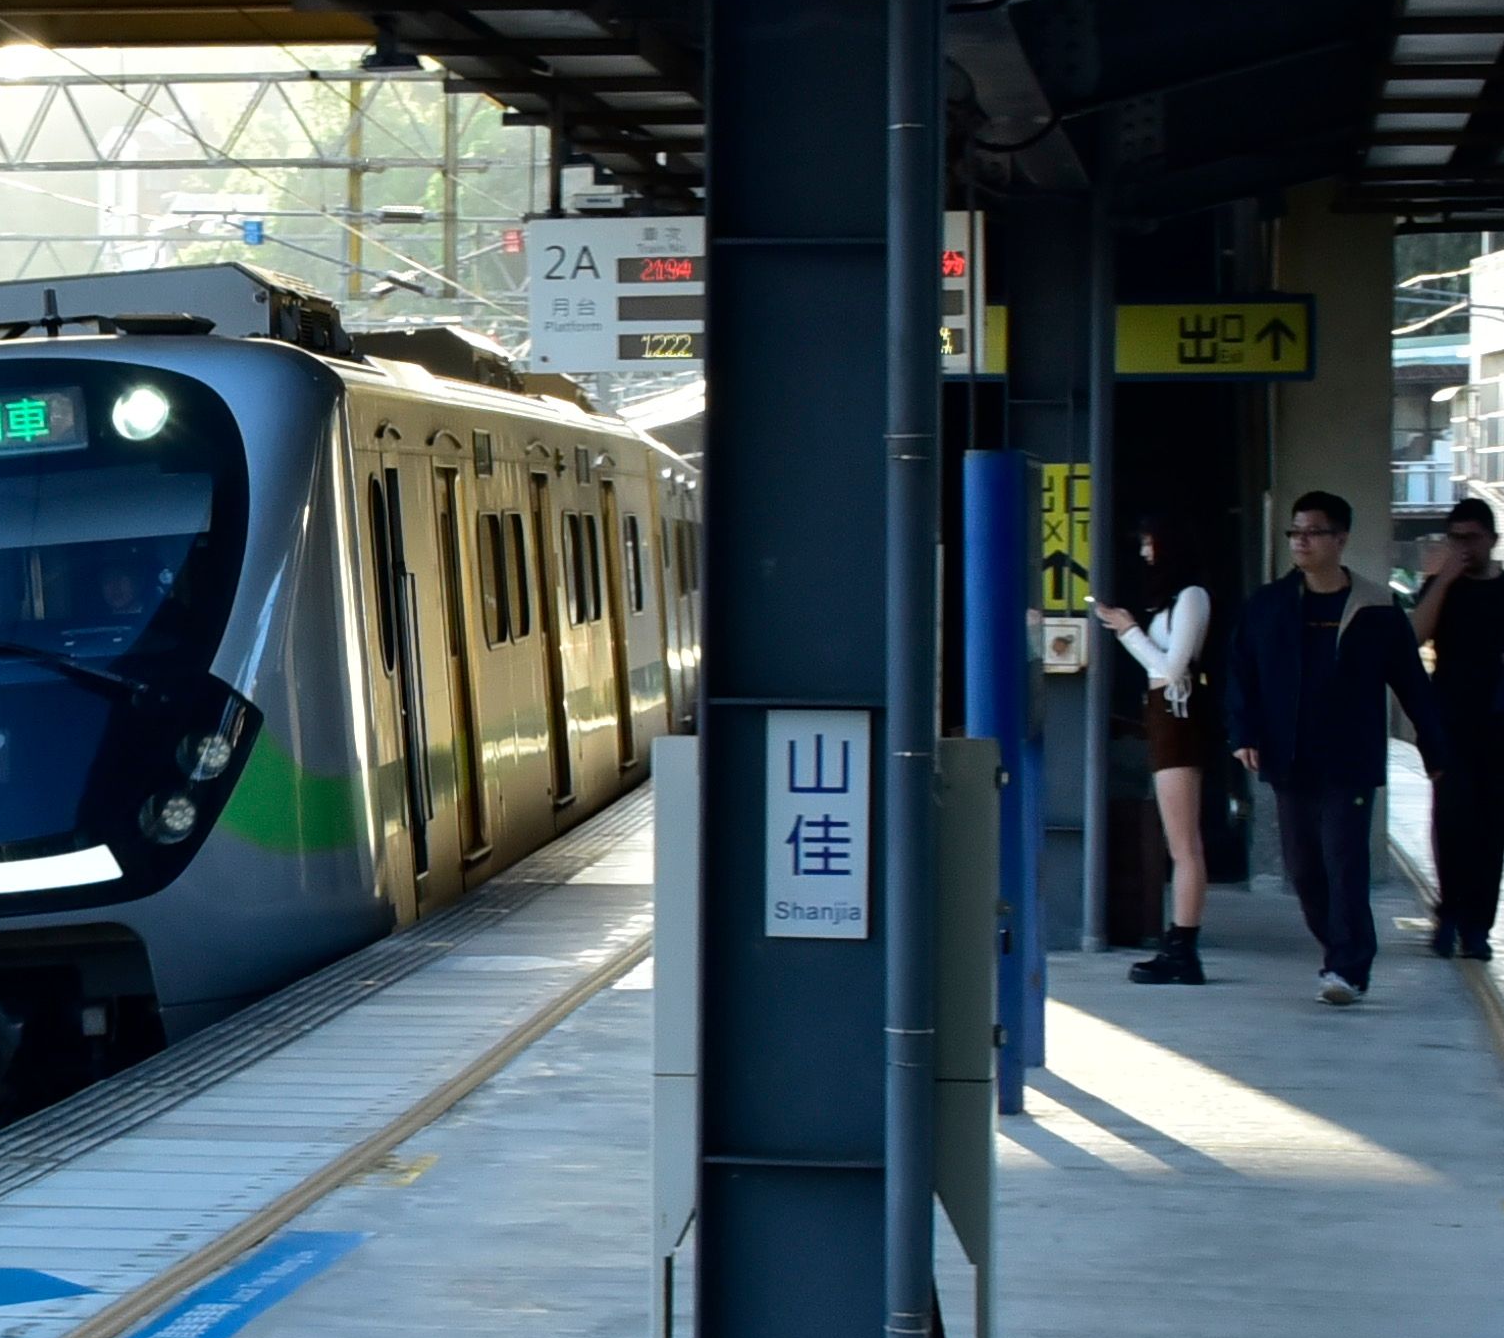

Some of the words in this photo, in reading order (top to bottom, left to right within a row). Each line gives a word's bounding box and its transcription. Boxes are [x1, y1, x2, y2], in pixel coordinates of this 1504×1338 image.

[544, 245, 601, 280] 2A
[552, 297, 596, 317] 月台
[1180, 315, 1243, 364] 出口
[785, 734, 852, 876] 山佳
[773, 901, 862, 925] Shanjia
